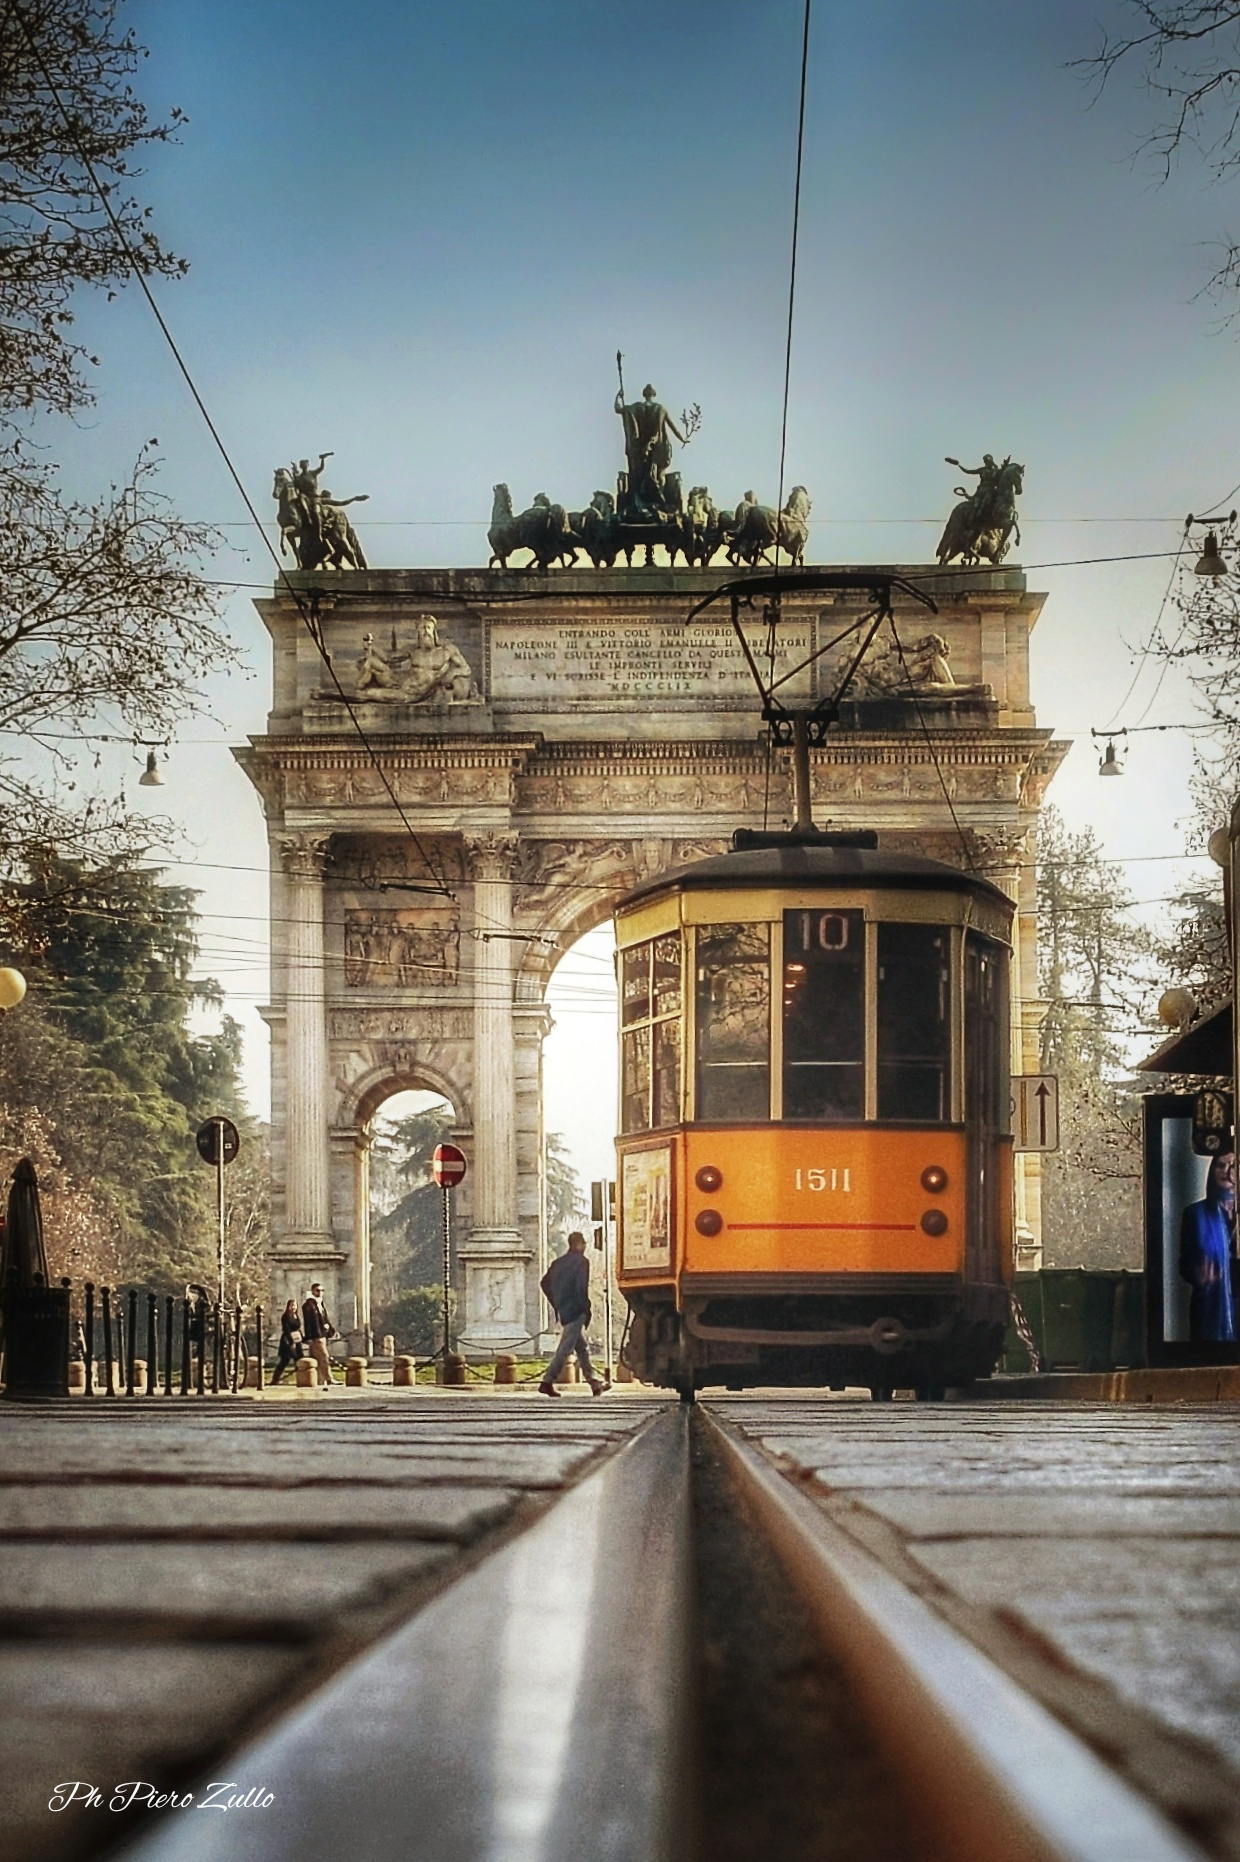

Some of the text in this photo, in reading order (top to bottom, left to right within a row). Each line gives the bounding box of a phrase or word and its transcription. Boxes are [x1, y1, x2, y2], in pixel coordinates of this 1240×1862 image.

[559, 630, 616, 638] ENTRANDO
[660, 628, 685, 637] ARMI
[495, 641, 558, 650] NAPOLEONE
[566, 641, 578, 649] III
[585, 641, 592, 649] E
[600, 640, 652, 649] VITTORIO
[659, 639, 717, 648] EMANUELE
[725, 639, 733, 647] II
[514, 651, 556, 660] MILANO
[564, 651, 621, 660] ESULTANTE
[688, 650, 702, 659] DA
[589, 661, 600, 670] LE
[530, 673, 537, 681] E
[545, 673, 557, 681] VI
[564, 672, 606, 681] SCRISSE
[627, 671, 710, 680] INDIPENDENZA
[734, 671, 771, 680] ITAIA
[801, 911, 849, 951] 10
[796, 1168, 851, 1192] 1511
